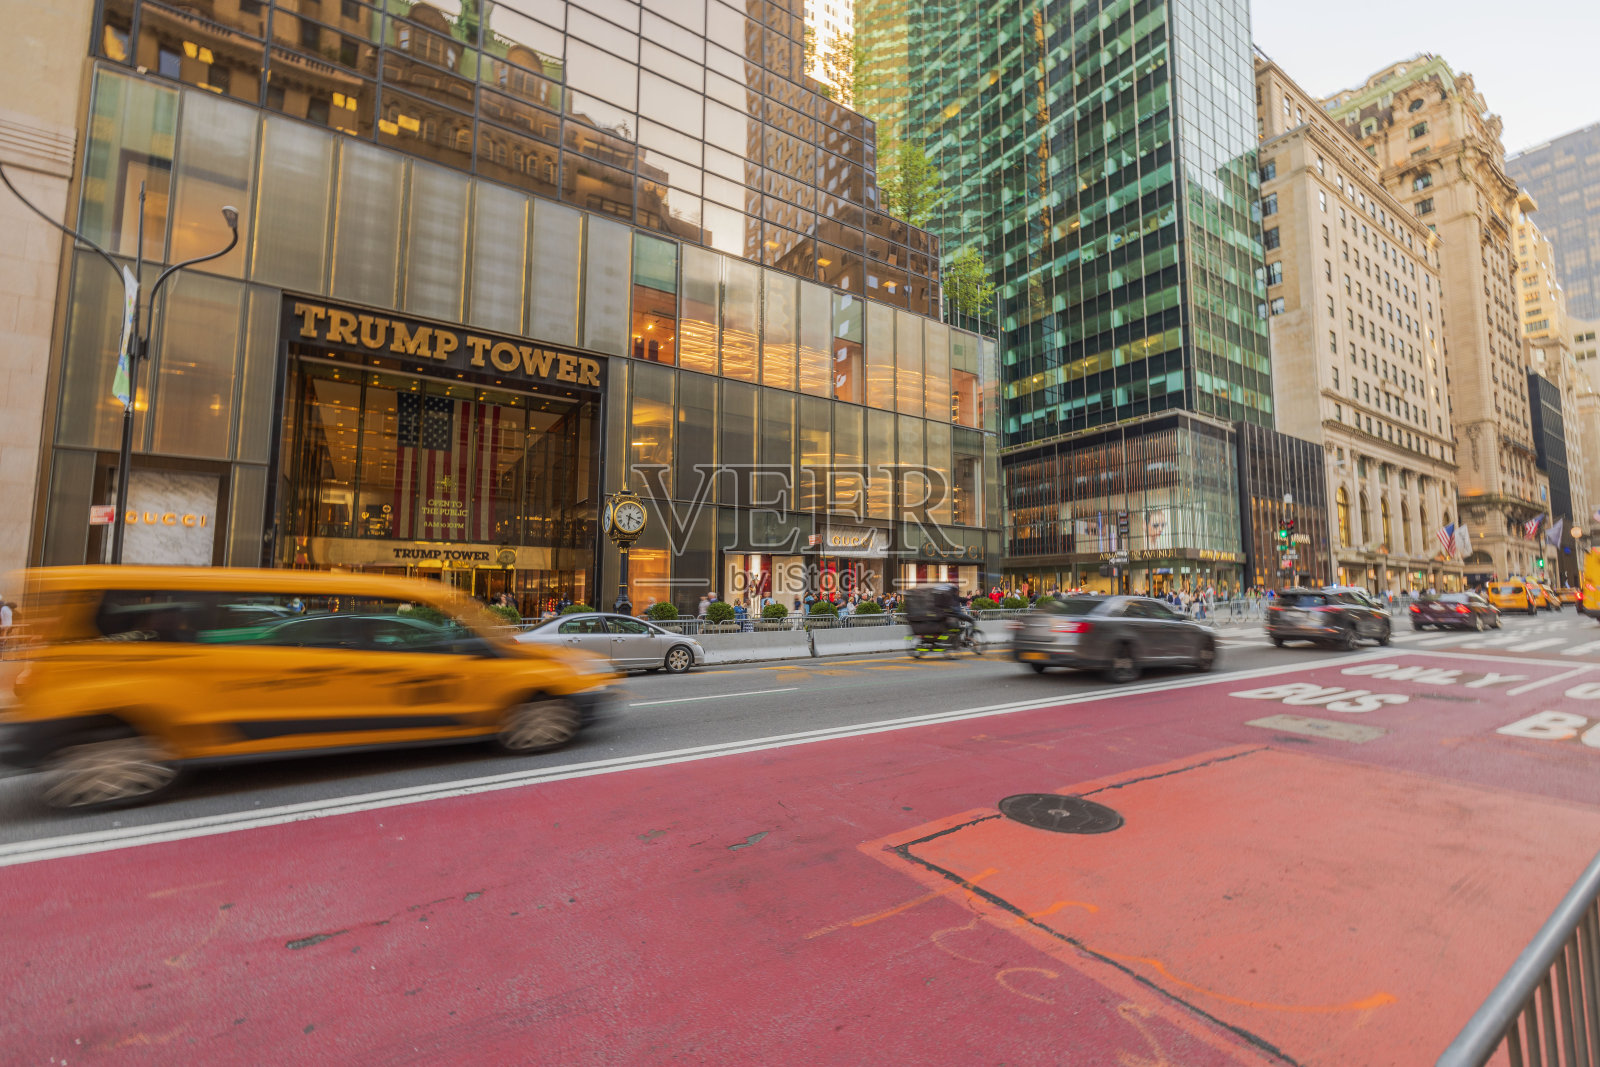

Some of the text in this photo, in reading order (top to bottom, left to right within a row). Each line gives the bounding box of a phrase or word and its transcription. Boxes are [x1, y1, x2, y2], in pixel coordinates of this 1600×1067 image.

[294, 302, 601, 387] TRUMP TOWER
[421, 506, 469, 517] THE PUBLIC
[428, 498, 463, 508] OPEN TO
[125, 510, 206, 527] GUCCI
[832, 535, 874, 548] GUCCI
[393, 548, 490, 561] TRUMP TOWER
[924, 542, 985, 560] GUCCI
[1341, 664, 1530, 688] ONLY
[1228, 682, 1410, 713] BUS
